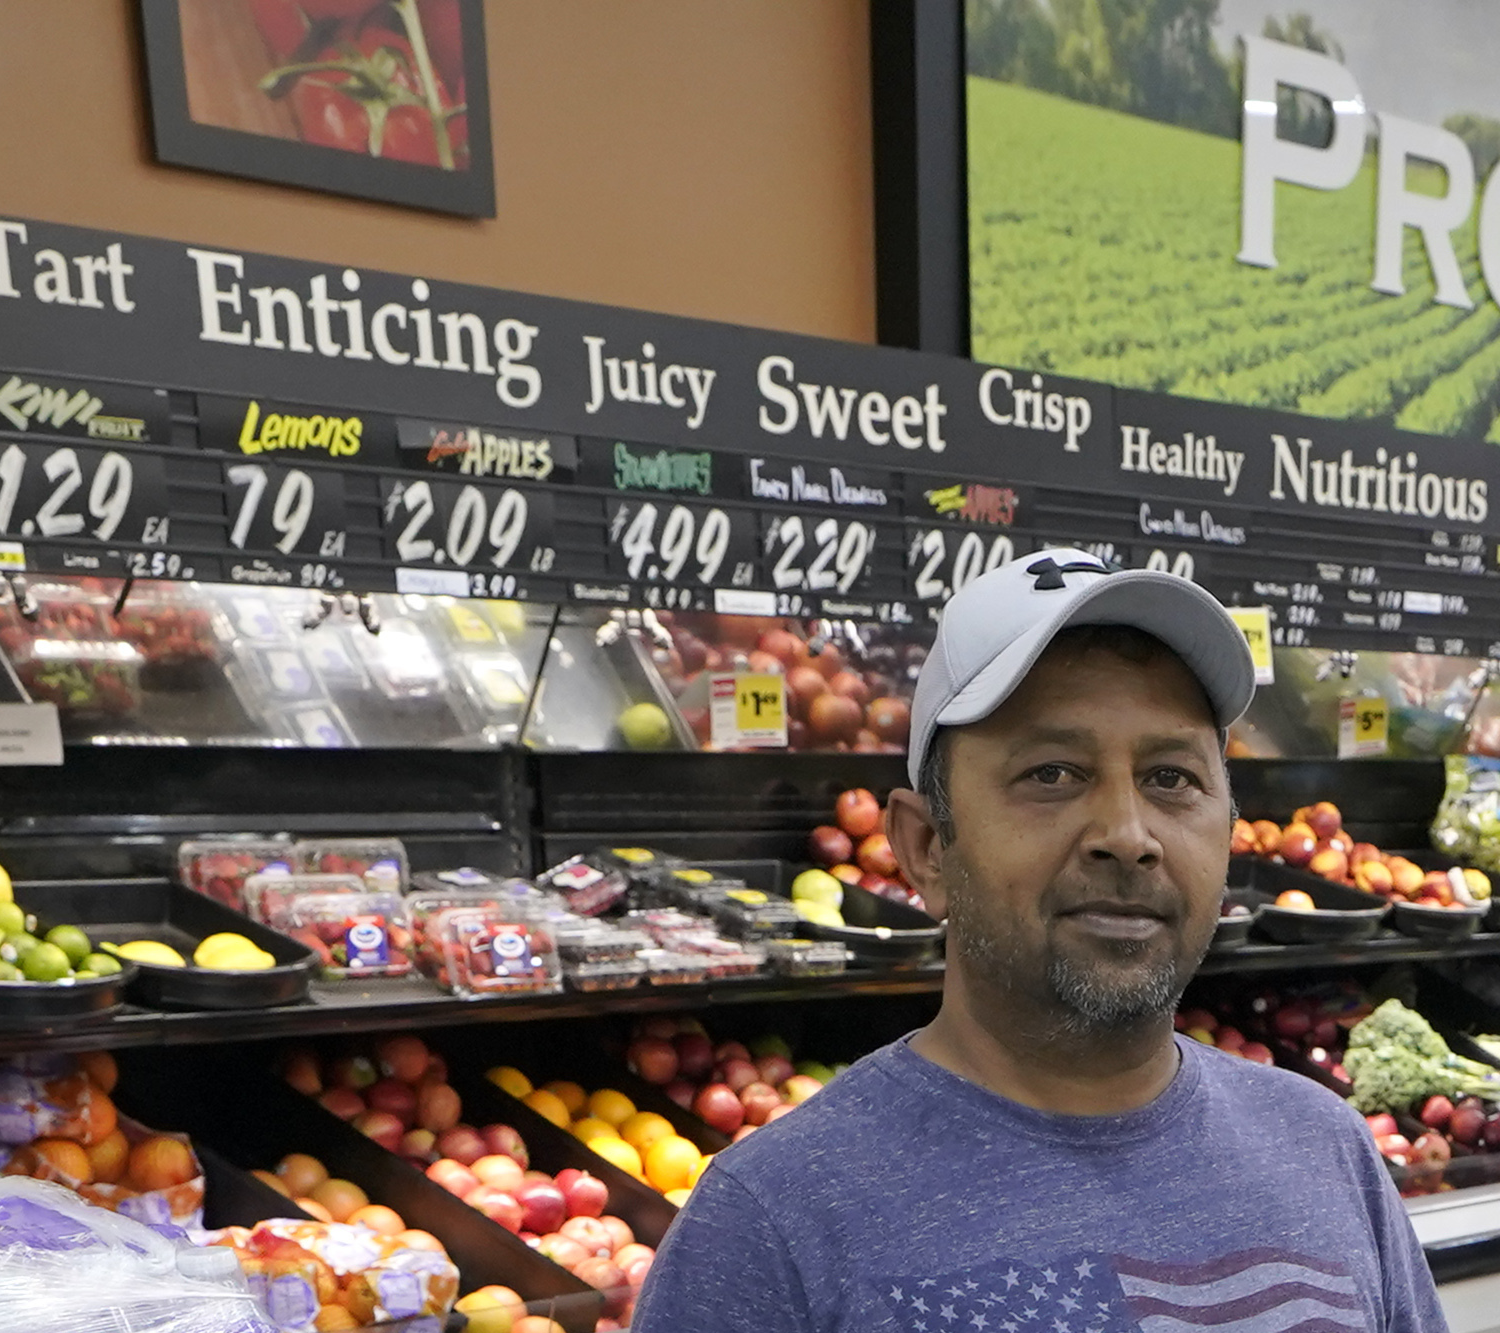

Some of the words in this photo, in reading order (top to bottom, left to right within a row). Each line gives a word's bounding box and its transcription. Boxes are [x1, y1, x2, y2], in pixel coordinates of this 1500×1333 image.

[186, 246, 542, 408] Enticing
[582, 336, 717, 430] Juicy
[757, 354, 949, 454] Sweet
[979, 368, 1092, 453] Crisp
[1120, 423, 1245, 496] Healthy
[1270, 434, 1489, 524] Nutritious
[239, 401, 362, 456] Lemons
[460, 428, 553, 480] APPLES
[228, 465, 314, 555] 79
